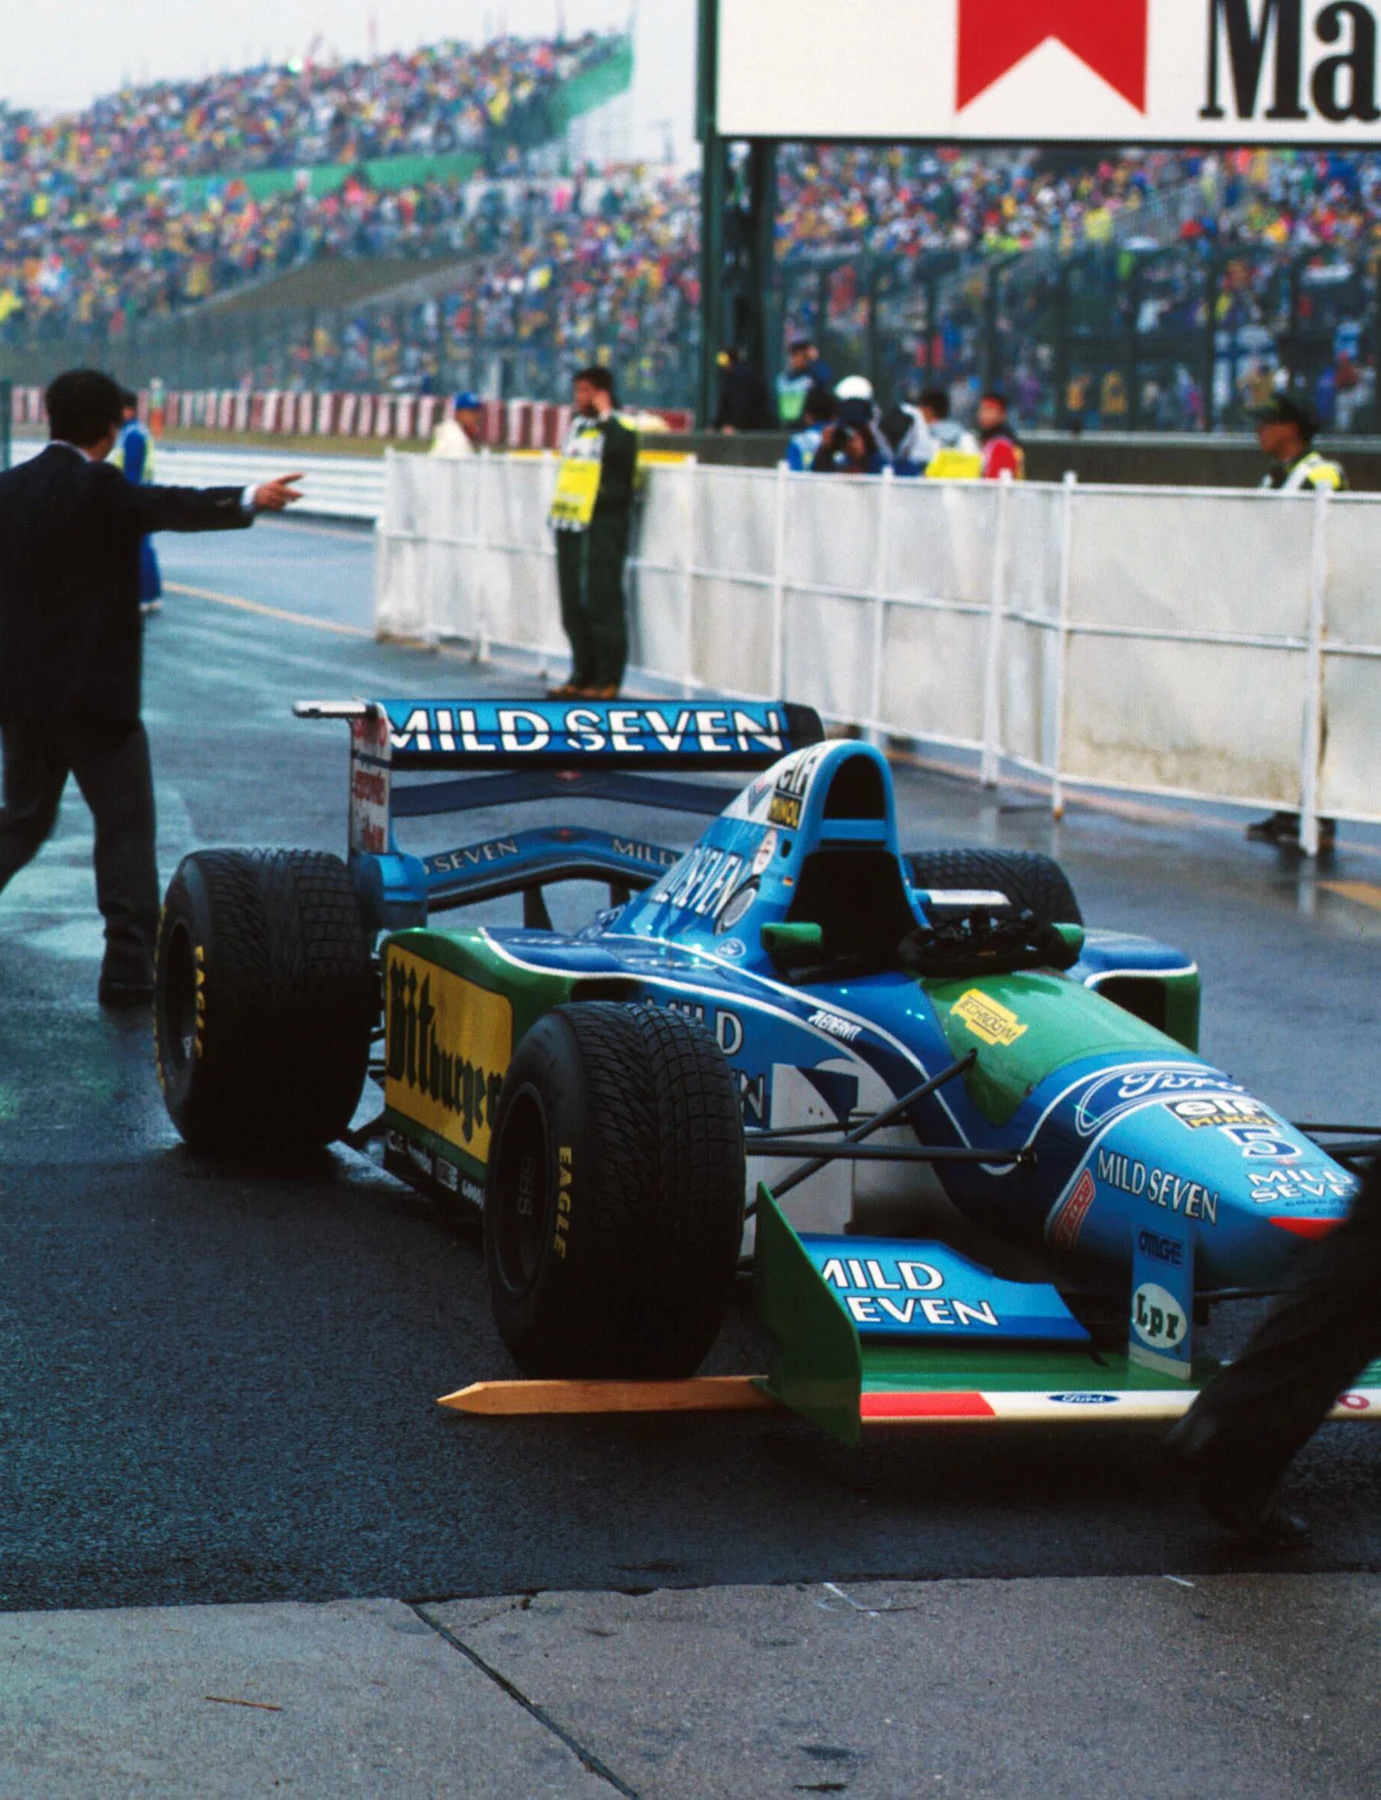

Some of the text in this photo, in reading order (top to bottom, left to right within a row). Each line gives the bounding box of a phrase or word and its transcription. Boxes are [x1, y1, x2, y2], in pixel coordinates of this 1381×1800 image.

[388, 709, 550, 752] MILD
[564, 709, 783, 752] SEVEN
[433, 839, 519, 876] SEVEN
[1118, 1067, 1245, 1099] Ford
[1174, 1100, 1263, 1118] elf
[1224, 1125, 1302, 1158] 5
[554, 1147, 572, 1259] EAGLE
[1097, 1148, 1143, 1198] MILD
[1147, 1169, 1220, 1226] SEVEN
[821, 1258, 944, 1291] MILD
[846, 1295, 999, 1327] EVEN
